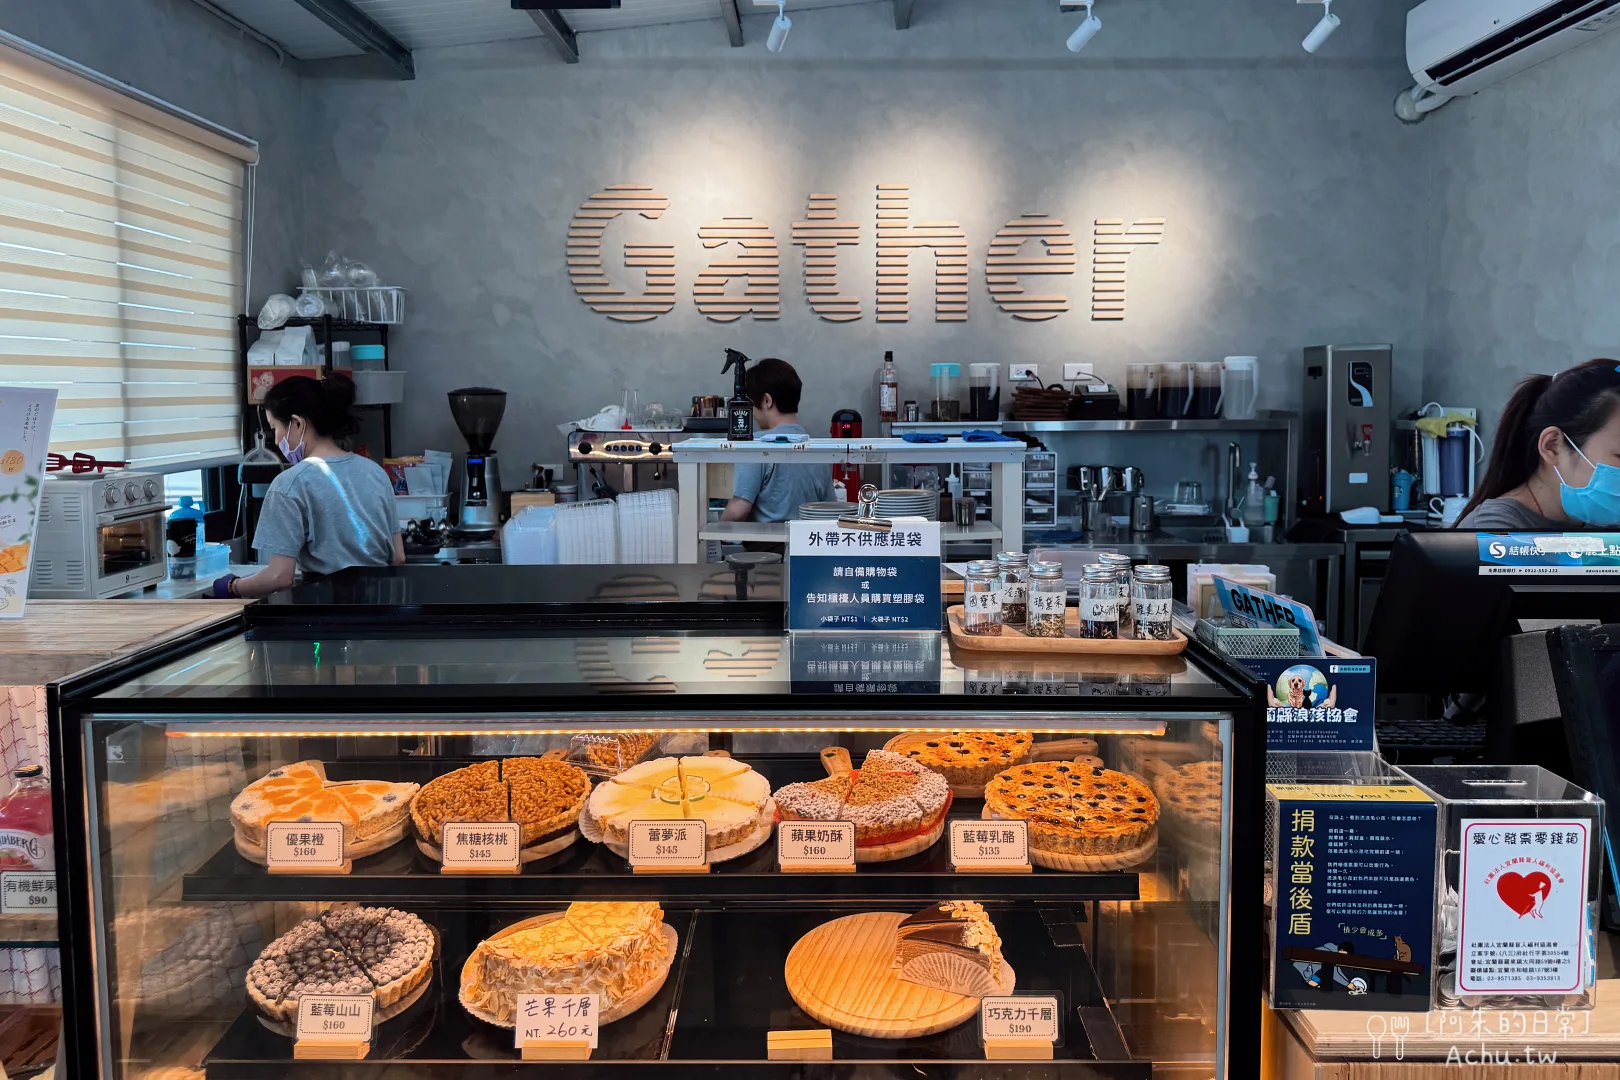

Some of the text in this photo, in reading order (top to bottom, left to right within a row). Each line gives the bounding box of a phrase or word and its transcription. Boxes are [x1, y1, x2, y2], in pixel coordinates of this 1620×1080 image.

[565, 182, 1167, 322] Gather
[808, 531, 922, 547] 外帶不供應提袋
[833, 566, 898, 577] 請自備購物袋
[860, 581, 870, 590] 或
[806, 592, 925, 604] 告知櫃檯人員購買塑膠袋
[285, 832, 325, 846] 優果橙
[456, 832, 508, 846] 焦糖核桃
[648, 827, 688, 842] 蕾夢派
[790, 828, 844, 843] 蘋果奶酥
[962, 829, 1016, 844] 藍莓乳酪
[1472, 831, 1579, 845] 愛心發票零錢箱
[293, 847, 317, 857] $160
[469, 849, 492, 859] $145
[655, 844, 678, 855] $145
[803, 845, 827, 856] $160
[978, 845, 1001, 856] $135
[1288, 808, 1315, 936] 捐款當後盾
[29, 895, 48, 906] $90
[309, 1003, 361, 1017] 藍莓山山
[987, 1007, 1052, 1021] 巧克力千層
[322, 1020, 346, 1030] $160
[546, 1023, 578, 1038] 260
[1009, 1023, 1033, 1034] $190
